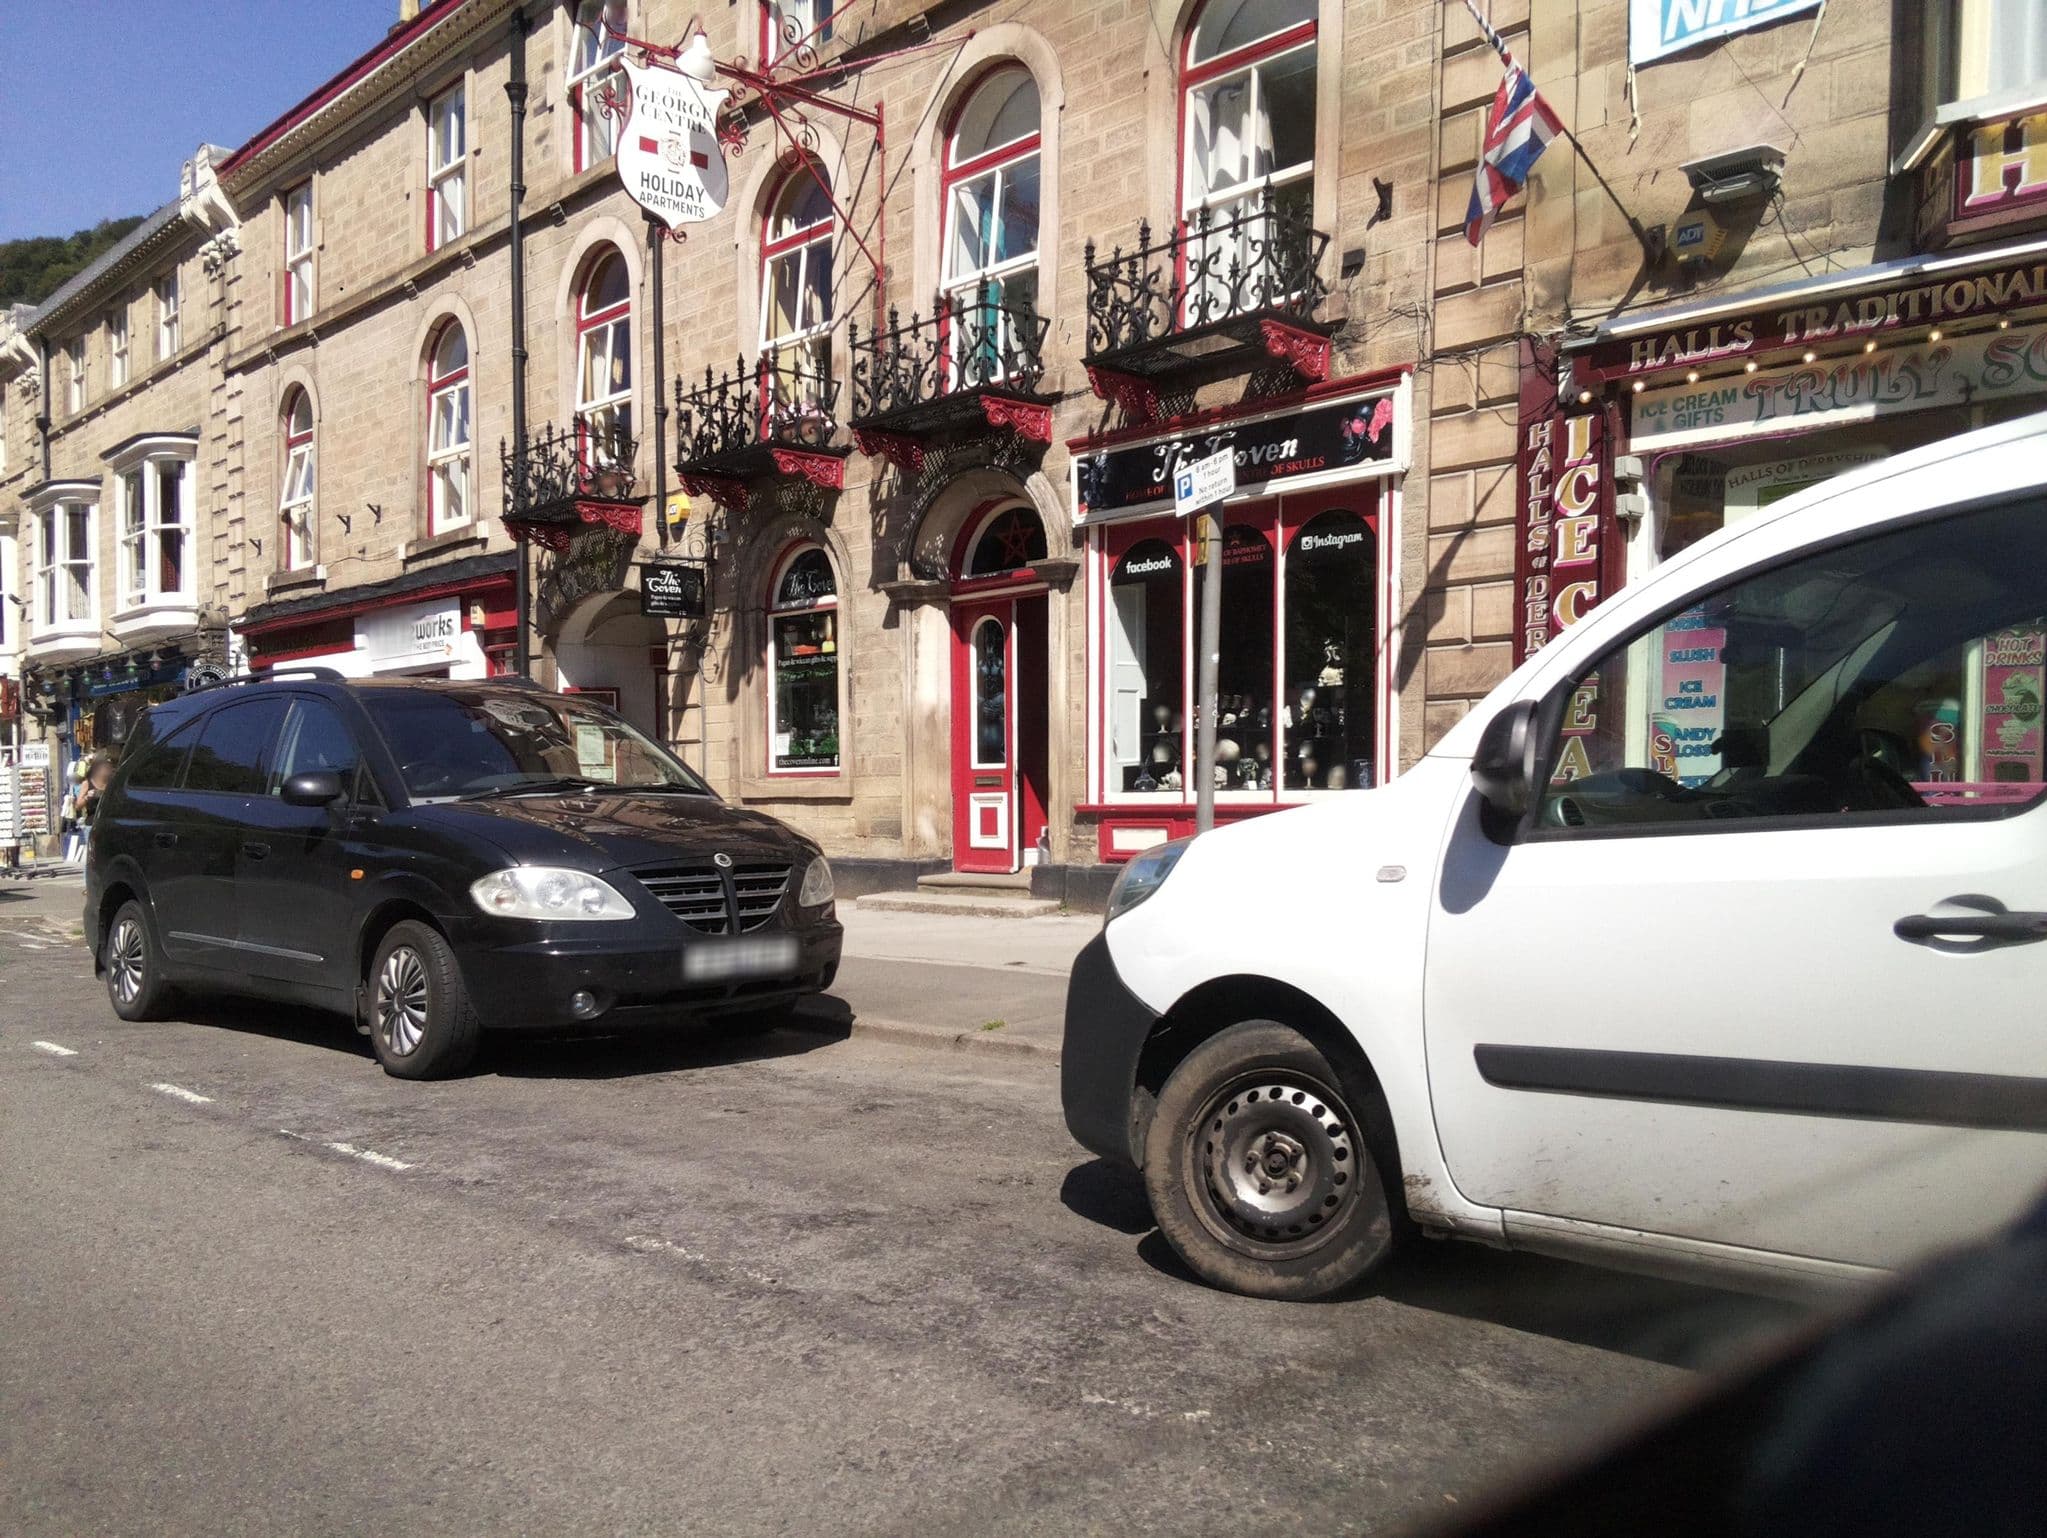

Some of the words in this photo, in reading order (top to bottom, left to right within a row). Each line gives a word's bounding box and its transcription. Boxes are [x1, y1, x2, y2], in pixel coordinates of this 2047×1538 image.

[636, 84, 712, 120] GEORGE
[641, 102, 706, 135] CENTRE
[640, 171, 704, 203] HOLIDAY
[639, 191, 705, 218] APARTMENTS
[1679, 226, 1704, 243] ADT
[1628, 320, 1755, 372] HALL'S
[1777, 266, 2047, 344] TRADITIONAL
[1742, 344, 1954, 426] TRULY
[1640, 401, 1668, 419] ICE
[1672, 388, 1738, 412] CREAM
[1673, 407, 1725, 429] GIFTS
[1207, 467, 1221, 477] hour
[1271, 463, 1286, 475] OF
[1287, 456, 1325, 472] SKULLS
[1208, 477, 1228, 490] return
[1527, 419, 1553, 553] HALLS
[1728, 465, 1773, 488] HALLS
[1219, 484, 1233, 495] hour
[1553, 415, 1599, 568] ICE
[1313, 530, 1364, 552] Instagram
[1126, 555, 1172, 575] facebook
[645, 577, 682, 594] Coven
[660, 570, 681, 586] The
[1524, 574, 1551, 660] DER
[1996, 637, 2031, 652] HOT
[1669, 647, 1716, 664] SLUSH
[1984, 651, 2042, 667] DRINKS
[1679, 679, 1704, 694] ICE
[1664, 694, 1717, 711] CREAM
[1675, 726, 1717, 743] ANDY
[1676, 743, 1714, 758] LOSS
